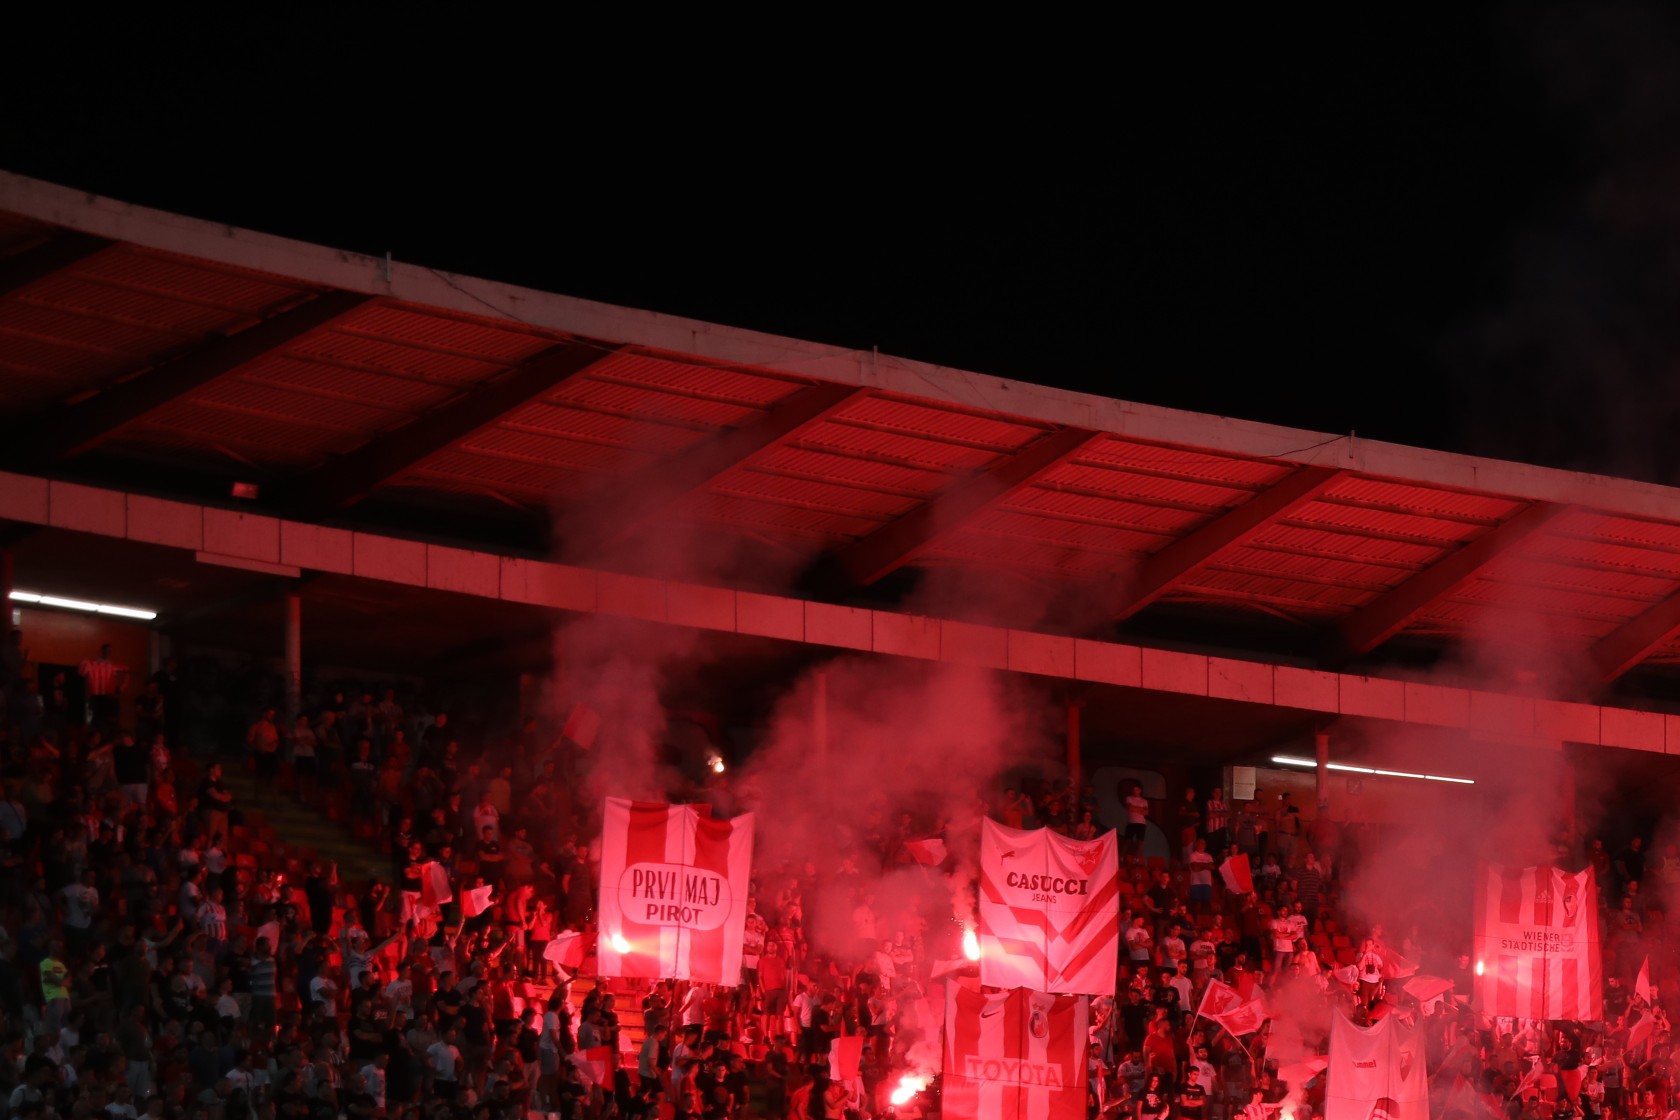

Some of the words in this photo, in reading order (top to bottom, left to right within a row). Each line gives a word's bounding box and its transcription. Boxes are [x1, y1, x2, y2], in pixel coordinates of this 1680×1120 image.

[632, 869, 676, 901] PRVI
[685, 874, 721, 906] MAJ
[1006, 871, 1088, 896] CASUCCI
[1031, 893, 1057, 904] JEANS
[646, 903, 703, 925] PIROT
[1523, 931, 1560, 942] WIENER
[968, 1059, 1059, 1086] TOYOTA
